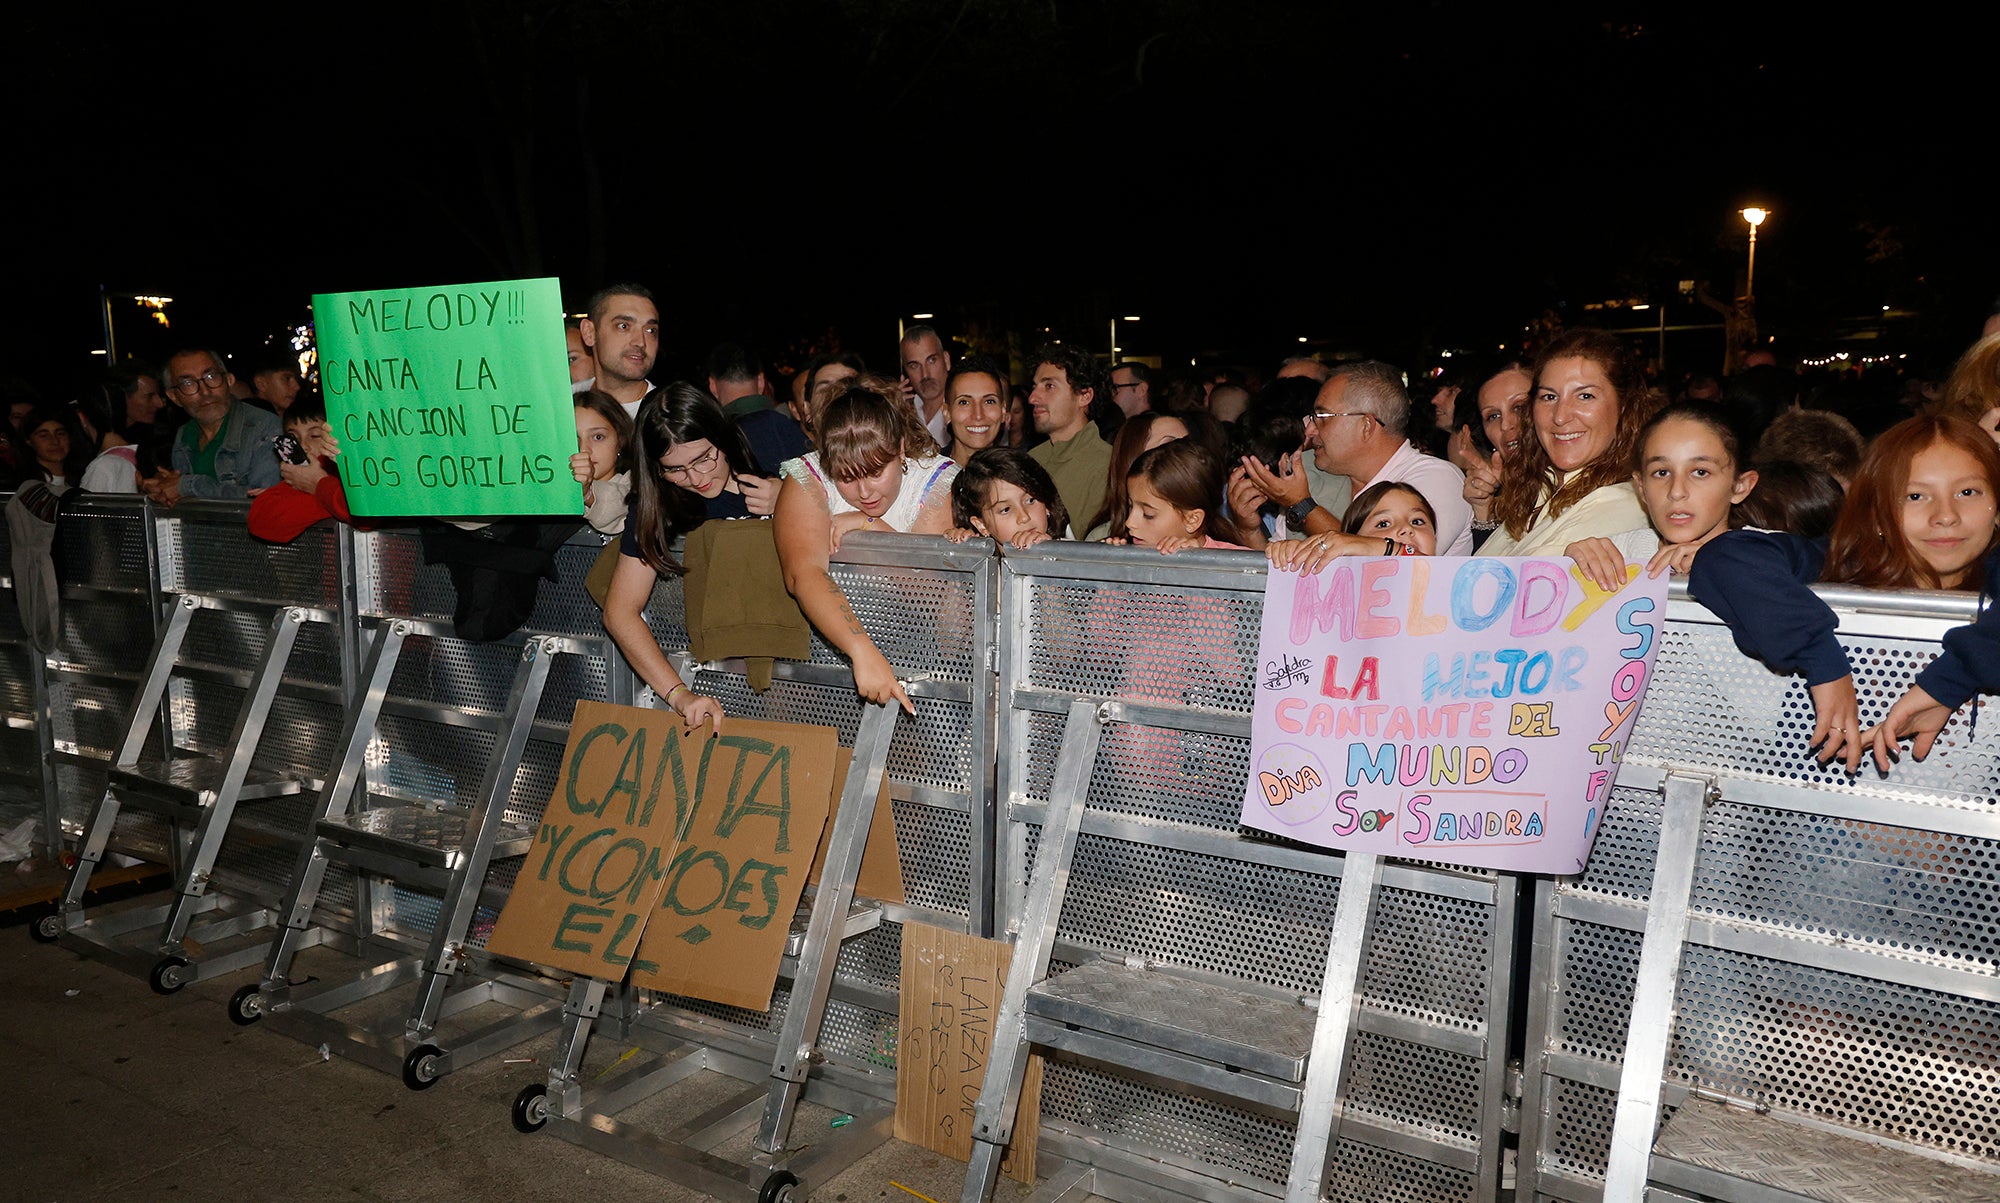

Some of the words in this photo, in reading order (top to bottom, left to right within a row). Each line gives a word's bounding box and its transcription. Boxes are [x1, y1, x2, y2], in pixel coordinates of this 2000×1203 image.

[349, 290, 525, 335] MELODY!!!
[326, 357, 419, 395] CANTA
[455, 357, 498, 391] LA
[344, 404, 467, 442] CANCION
[491, 404, 531, 435] DE
[344, 456, 400, 487] LOS
[417, 454, 555, 488] GORILAS
[1289, 558, 1643, 646] MELODY
[1320, 655, 1380, 700] LA
[1421, 646, 1589, 701] MEJOR
[1275, 697, 1495, 740] CANTANTE
[1508, 701, 1561, 738] DEL
[566, 722, 793, 854] CANTA
[1346, 743, 1528, 787] MUNDO
[1403, 795, 1544, 844] SANDRA
[930, 1002, 954, 1095] BESO
[960, 976, 988, 1074] LANZA
